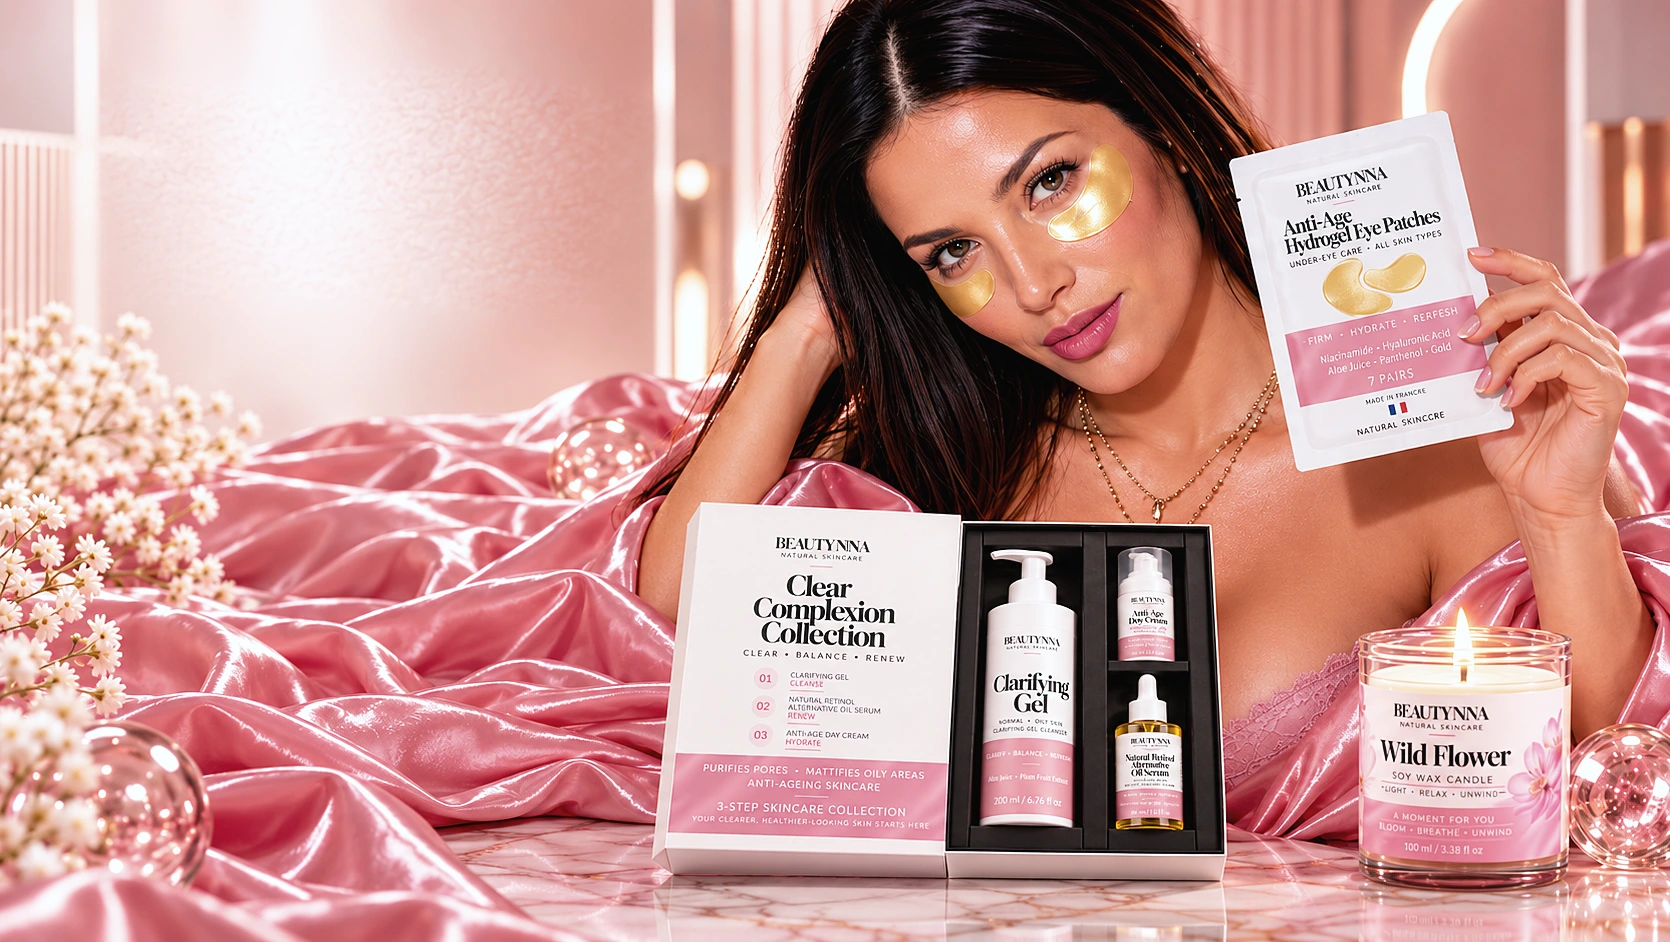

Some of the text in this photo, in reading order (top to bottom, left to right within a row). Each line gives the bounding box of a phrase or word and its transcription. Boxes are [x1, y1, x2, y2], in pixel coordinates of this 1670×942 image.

[1296, 166, 1388, 198] BEAUTYNNA
[1307, 184, 1382, 205] NATURAL SKINCARE
[1283, 211, 1353, 237] Anti-Age
[1284, 210, 1441, 256] Hydrogel Eye Patches
[1289, 229, 1442, 268] UNDER-EYE CARE ALL SKIN TYPES
[1308, 333, 1333, 345] FIRM
[1350, 320, 1397, 336] HYDRATE
[1382, 332, 1430, 351] Hyaluronic
[1432, 328, 1451, 340] Acid
[1328, 342, 1452, 375] Aloe Juice Panthenol Gold
[1368, 368, 1414, 386] 7 PAIRS
[1365, 395, 1384, 405] MADE
[1357, 422, 1398, 436] NATURAL
[776, 537, 870, 553] BEAUTYNNA
[787, 574, 852, 598] Clear
[753, 597, 895, 626] Complexion
[761, 621, 885, 648] Collection
[1004, 635, 1060, 647] BEAUTYNNA
[743, 650, 905, 662] CLEAR BALANCE RENEW
[760, 674, 771, 683] 01
[790, 672, 833, 680] CLARIFYING
[790, 680, 824, 688] CLEANSE
[993, 672, 1070, 700] Clarifying
[756, 702, 770, 711] 02
[854, 706, 881, 714] SERUM
[1014, 693, 1048, 713] Gel
[788, 712, 815, 720] RENEW
[1394, 703, 1489, 721] BEAUTYNNA
[1400, 721, 1436, 730] NATURAL
[754, 730, 768, 740] 03
[785, 738, 821, 746] HYDRATE
[1381, 739, 1511, 768] Wild Flower
[703, 763, 924, 780] PURIFIES PORES MATTIFIES OILY AREAS
[1392, 771, 1493, 784] SOY WAX CANDLE
[747, 779, 880, 792] ANTI-AGEING SKINCARE
[1385, 786, 1498, 798] LIGHT RELAX UNWIND
[994, 796, 1008, 805] 200
[1010, 796, 1020, 804] ml
[1027, 796, 1044, 804] 6.76
[717, 801, 906, 817] 3-STEP SKINCARE COLLECTION
[1393, 811, 1495, 824] A MOMENT FOR YOU
[1379, 821, 1512, 837] BLOOM BREATHE UNWIND
[1404, 842, 1419, 852] 100
[1421, 843, 1432, 853] ml
[1440, 844, 1461, 854] 3.38
[1463, 844, 1470, 854] fl
[1472, 846, 1483, 854] oz
